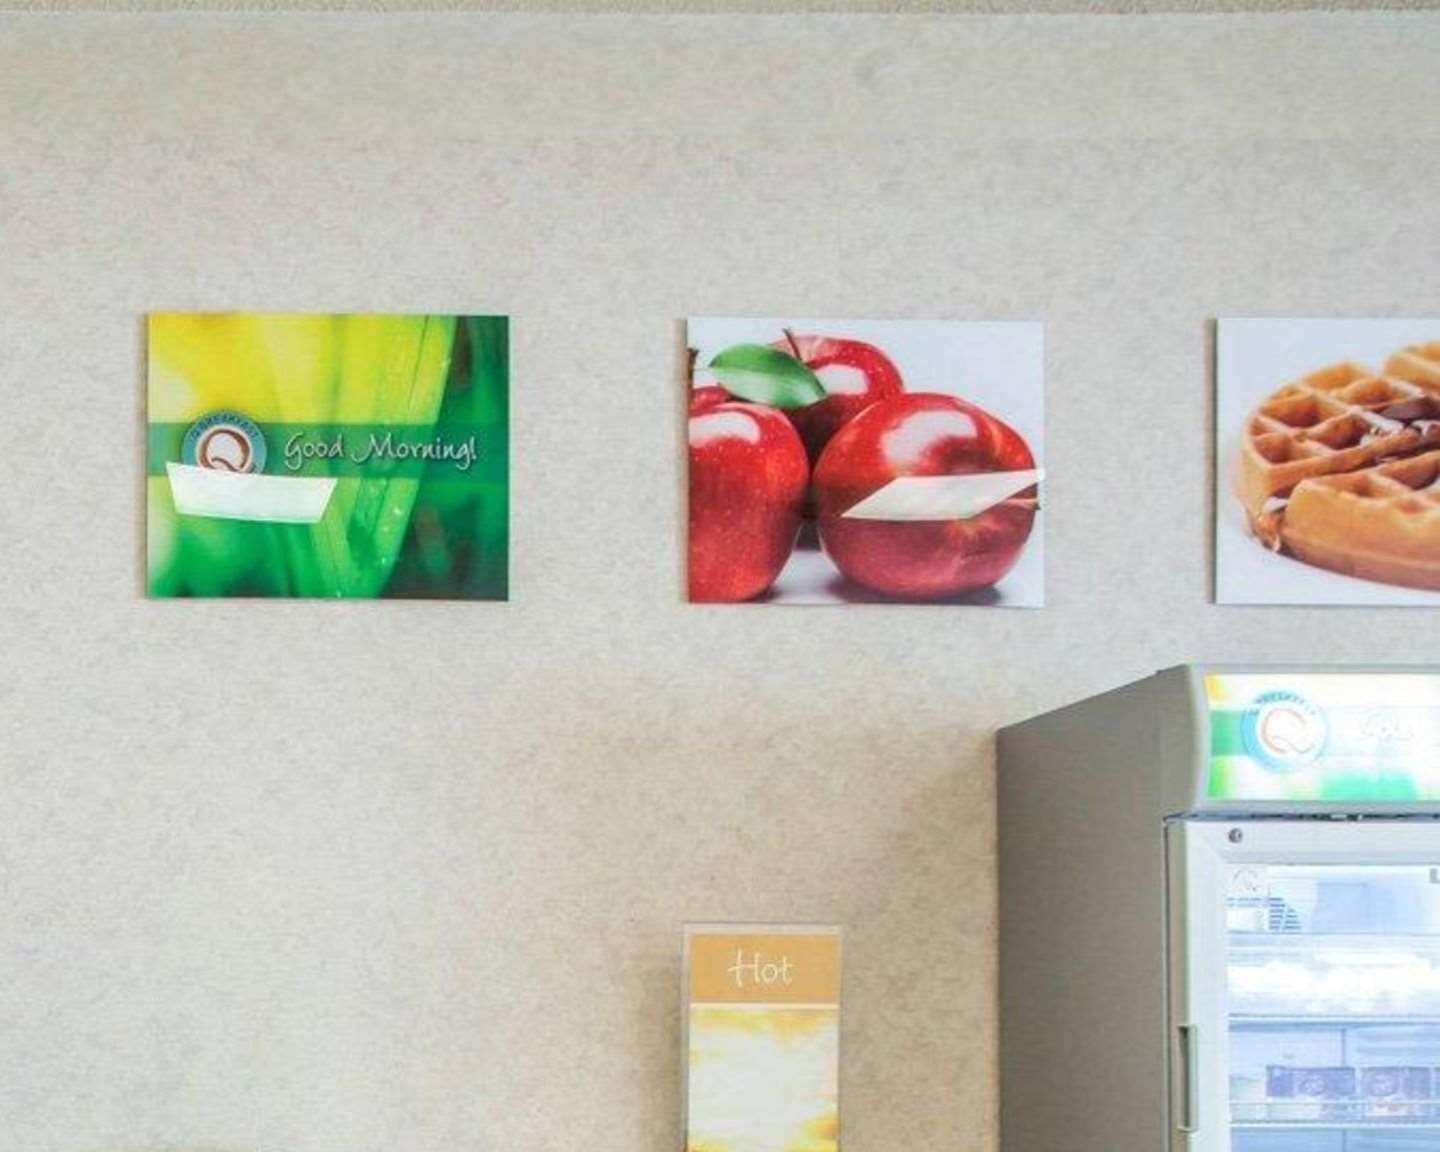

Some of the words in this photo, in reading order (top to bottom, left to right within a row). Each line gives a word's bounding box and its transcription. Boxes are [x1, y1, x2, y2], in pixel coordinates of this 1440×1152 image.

[283, 431, 345, 471] Good
[350, 431, 477, 471] Morning!
[727, 947, 794, 989] Hot
